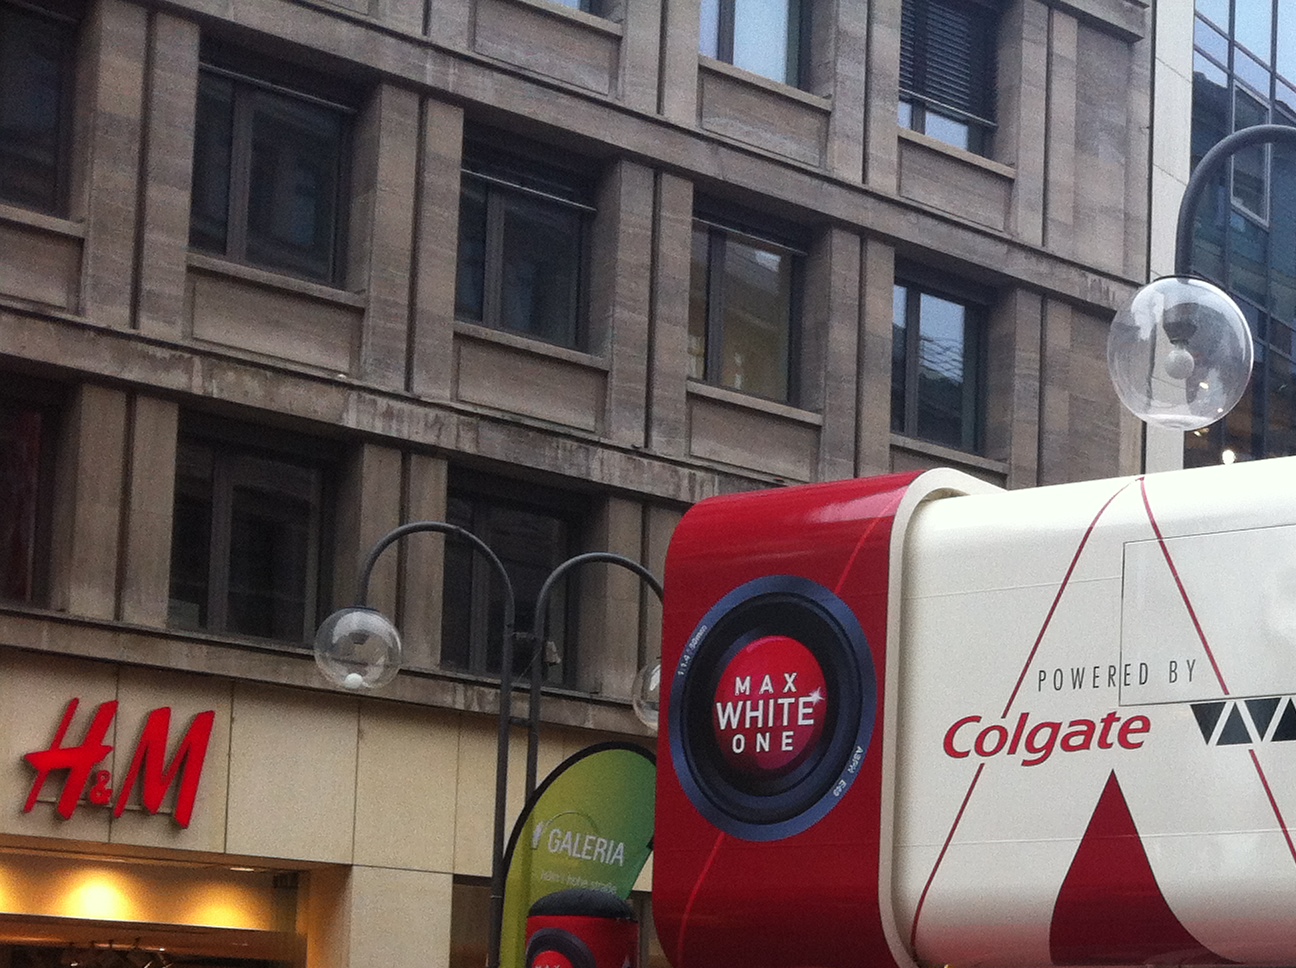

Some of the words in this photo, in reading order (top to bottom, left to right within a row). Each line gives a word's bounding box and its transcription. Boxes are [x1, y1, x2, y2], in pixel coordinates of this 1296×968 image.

[734, 672, 797, 695] MAX
[1037, 661, 1149, 693] POWERED
[1168, 659, 1197, 684] BY
[715, 696, 816, 730] WHITE
[731, 731, 795, 754] ONE
[942, 710, 1151, 767] Colgate
[23, 696, 216, 830] H&M
[547, 828, 625, 867] GALERIA
